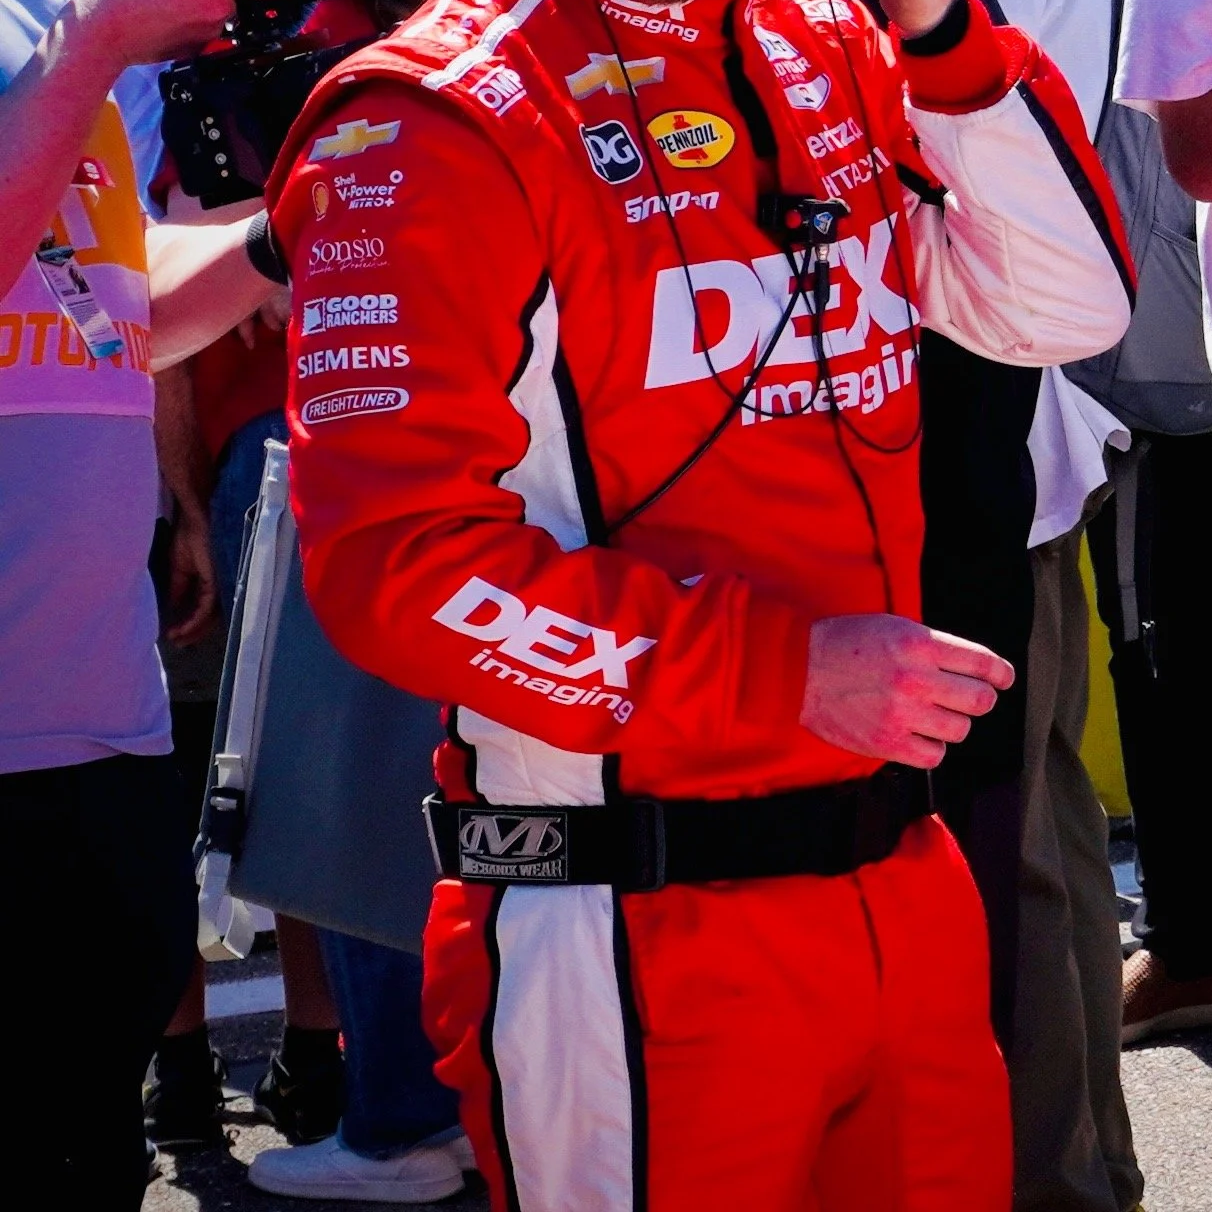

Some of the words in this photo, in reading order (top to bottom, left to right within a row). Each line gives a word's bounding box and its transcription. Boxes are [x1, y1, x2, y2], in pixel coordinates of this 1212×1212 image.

[601, 1, 699, 43] imaging
[656, 123, 719, 154] PENNZOIL
[334, 173, 356, 187] Shell
[336, 185, 397, 202] V-Power
[308, 229, 385, 266] Sonsio
[326, 294, 399, 312] GOOD
[644, 212, 921, 390] DEX
[326, 309, 399, 326] RANCHERS
[297, 344, 411, 379] SIEMENS
[308, 392, 397, 417] FREIGHTLINER
[431, 576, 658, 689] DEX
[469, 648, 634, 724] imaging
[519, 860, 563, 878] WEAR
